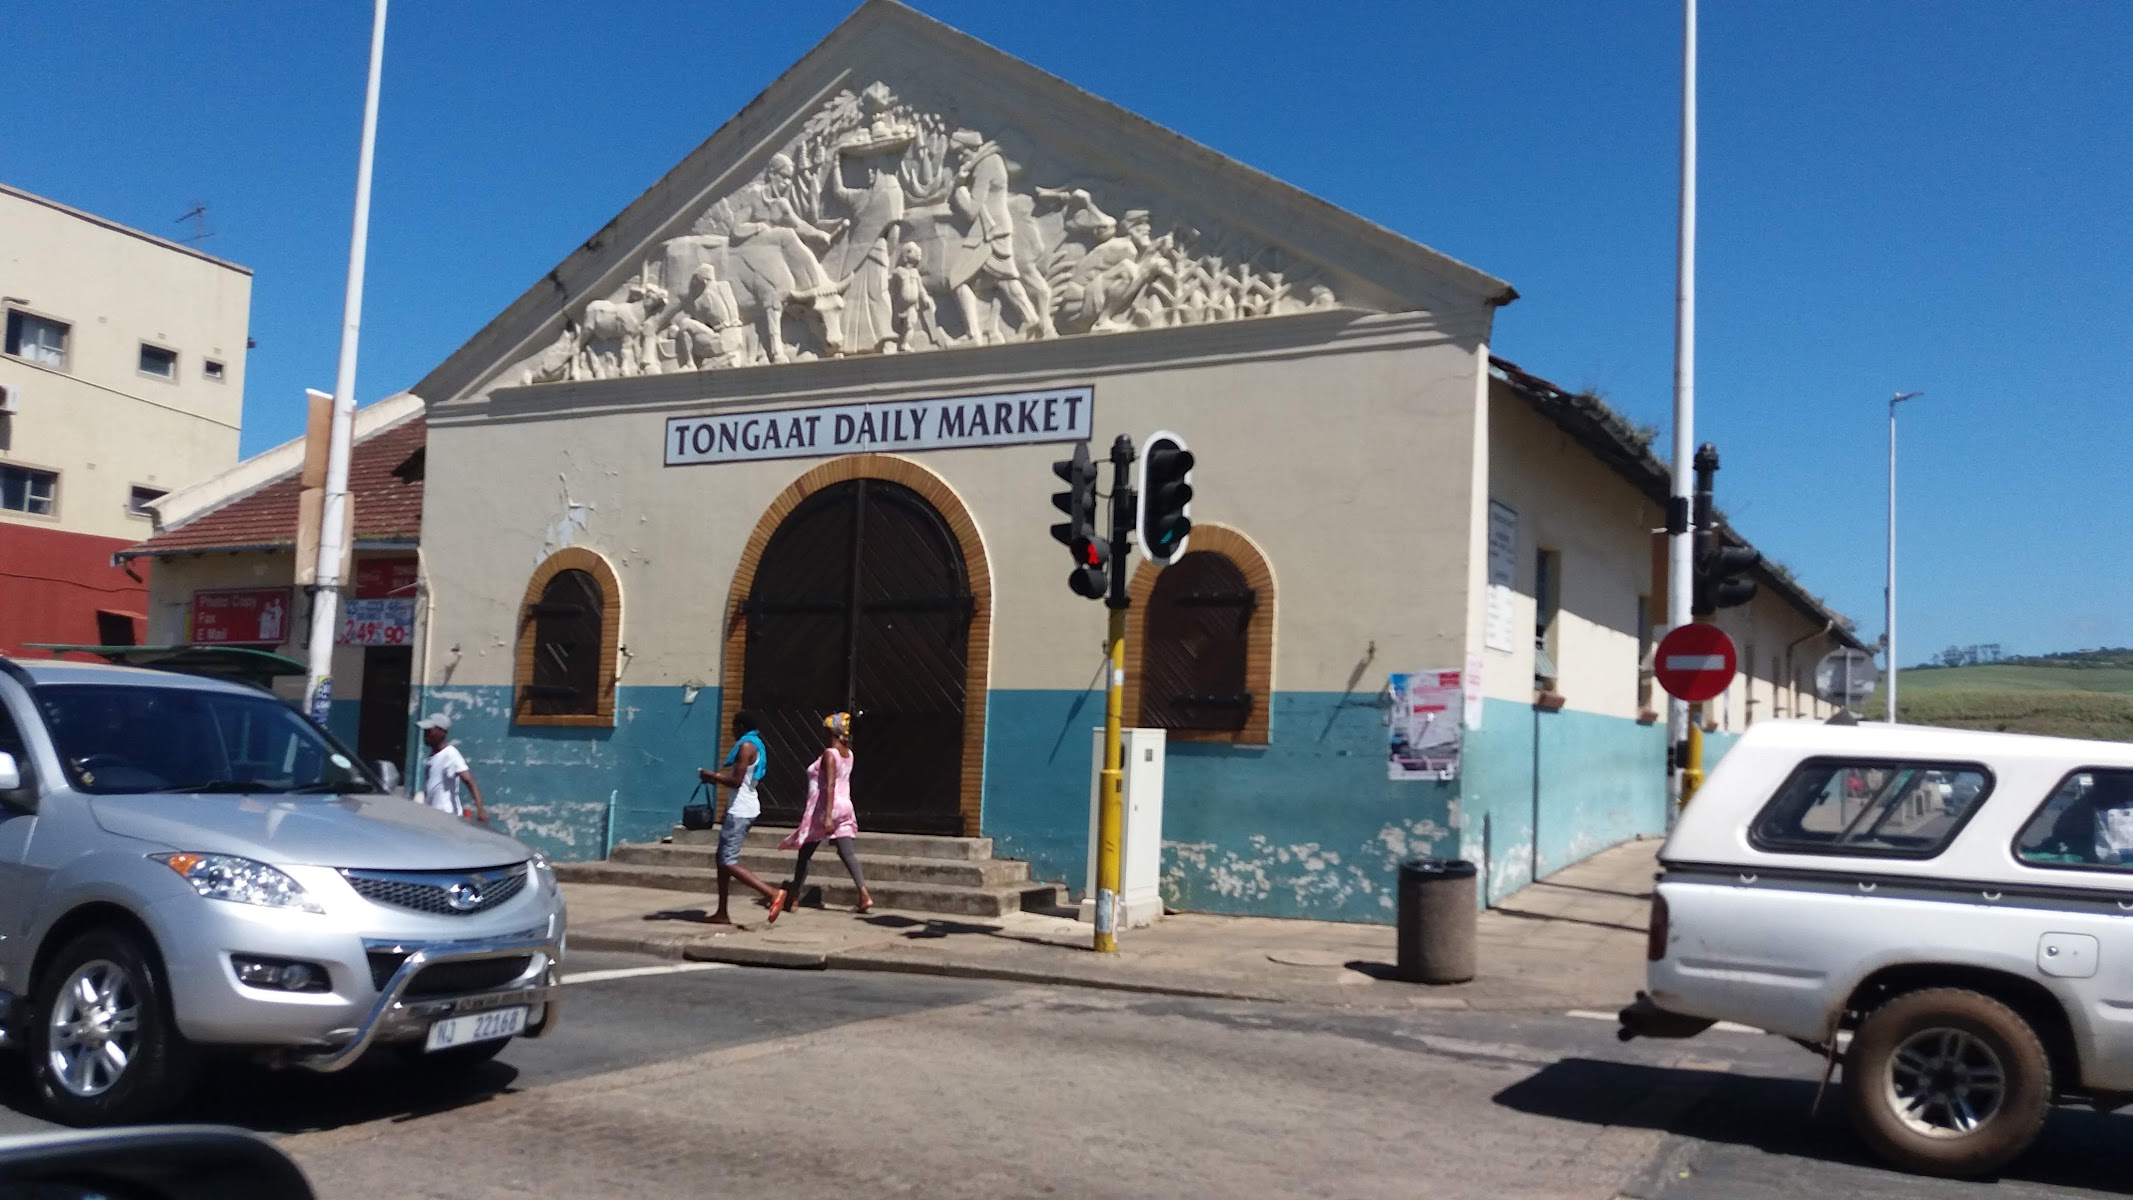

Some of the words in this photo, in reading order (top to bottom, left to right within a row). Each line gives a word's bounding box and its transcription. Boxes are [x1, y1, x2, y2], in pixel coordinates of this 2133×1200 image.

[675, 414, 821, 456] TONGAAT
[833, 407, 928, 446] DAILY
[937, 396, 1084, 439] MARKET
[198, 611, 217, 624] Fax
